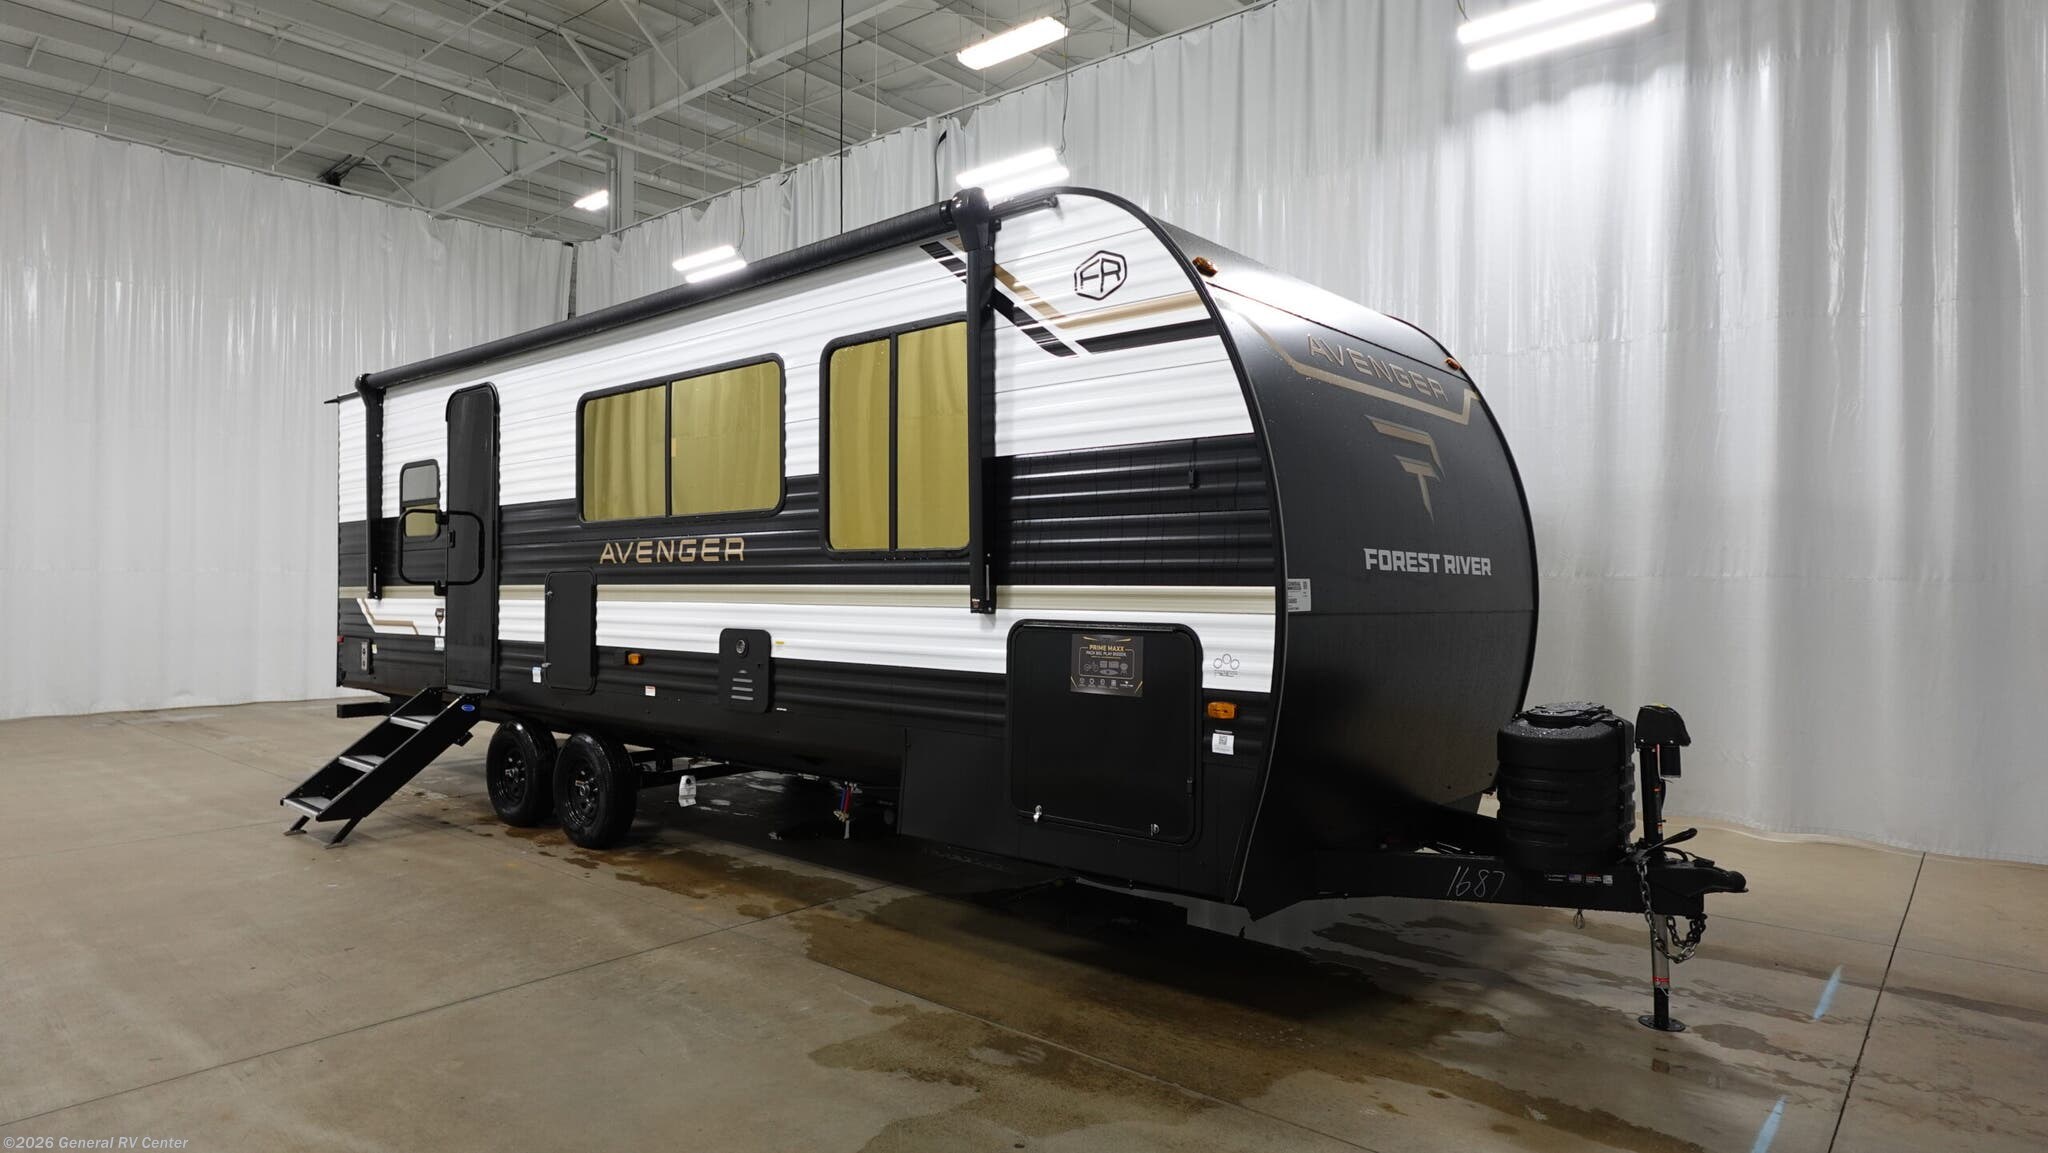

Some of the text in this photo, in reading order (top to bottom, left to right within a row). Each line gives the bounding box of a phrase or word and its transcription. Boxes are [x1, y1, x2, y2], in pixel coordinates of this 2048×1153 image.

[1308, 334, 1449, 401] AVENGER
[600, 537, 745, 564] AVENGER
[1363, 548, 1492, 576] FOREST RIVER
[1446, 865, 1505, 897] 1687
